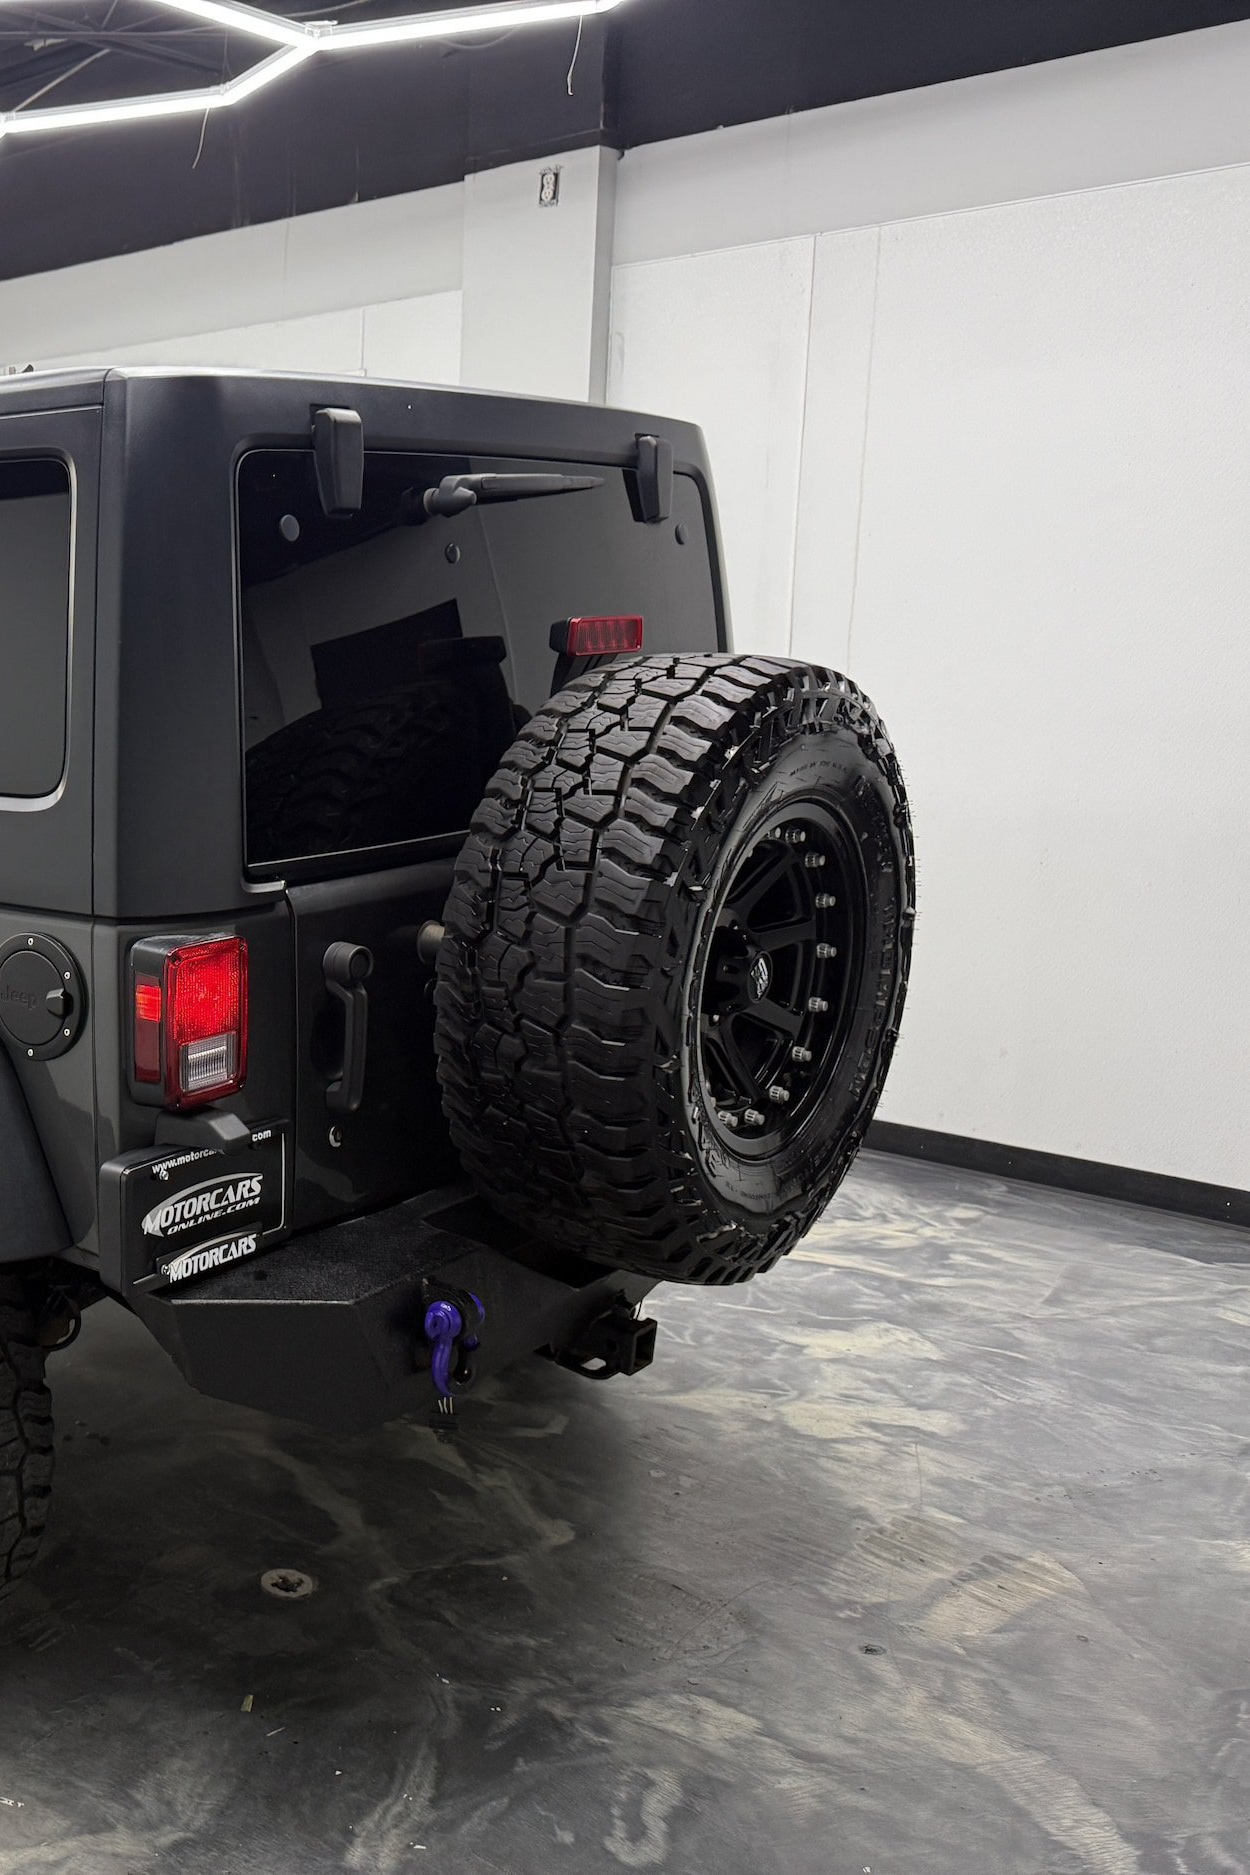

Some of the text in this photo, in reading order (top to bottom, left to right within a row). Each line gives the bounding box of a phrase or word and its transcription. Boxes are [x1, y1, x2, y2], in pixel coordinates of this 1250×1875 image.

[0, 984, 37, 1010] Jeep
[144, 1174, 263, 1235] MOTORCARS
[167, 1197, 261, 1236] ONLINE.COM
[169, 1233, 258, 1283] MOTORCARS
